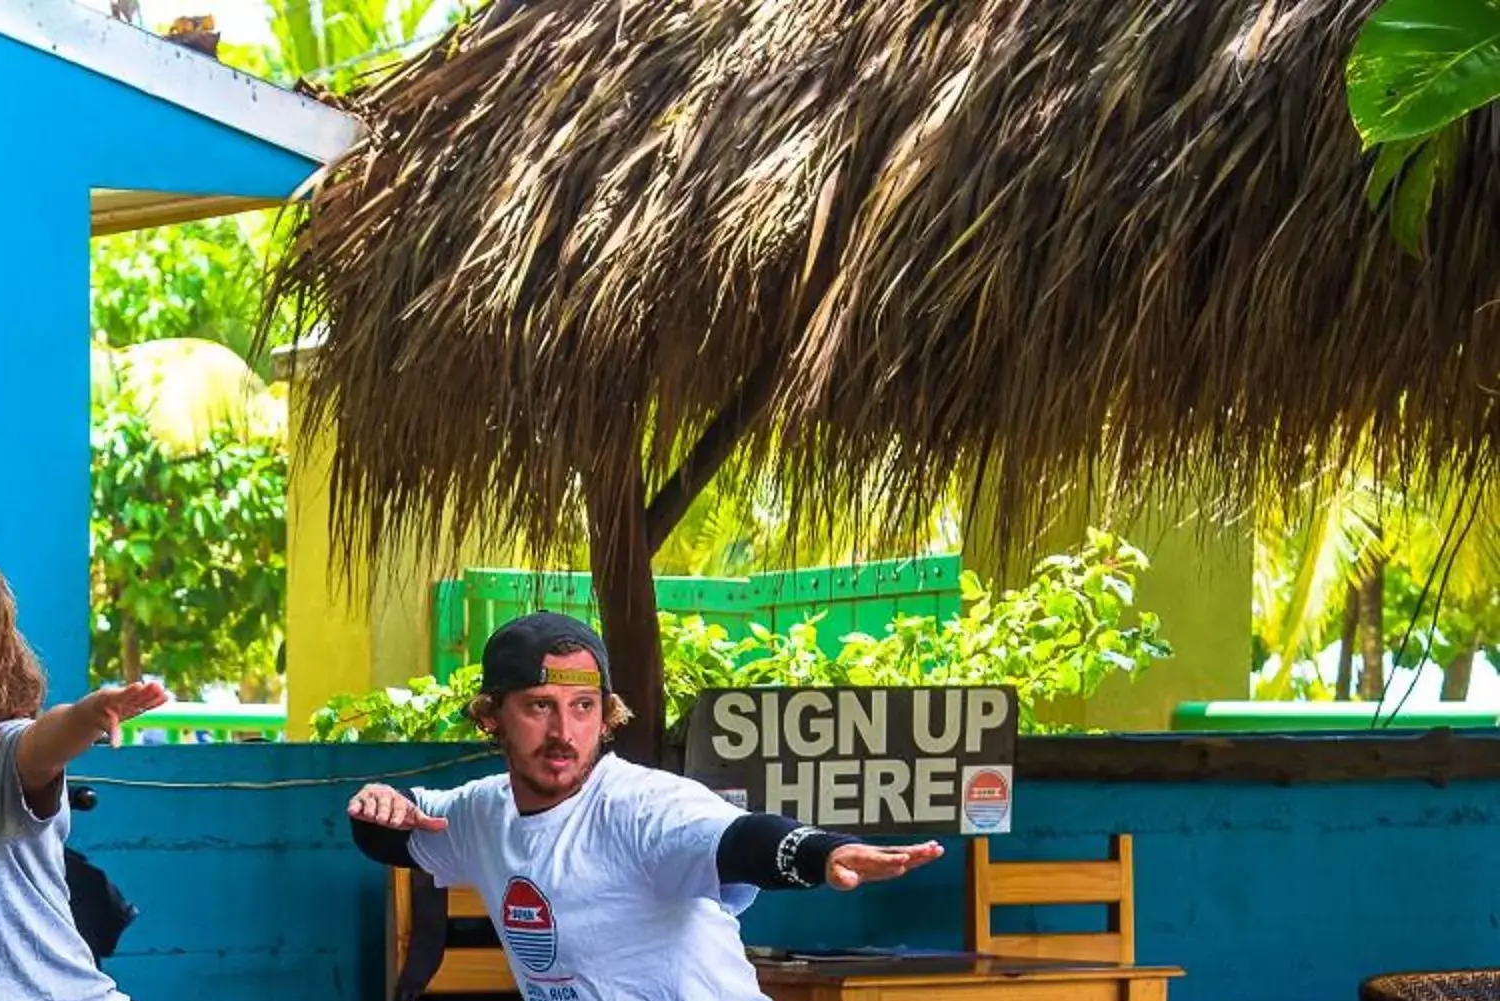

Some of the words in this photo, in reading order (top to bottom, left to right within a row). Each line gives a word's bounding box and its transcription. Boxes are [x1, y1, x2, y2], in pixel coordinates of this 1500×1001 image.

[711, 690, 887, 760] SIGN
[912, 689, 1009, 754] UP
[765, 757, 957, 827] HERE
